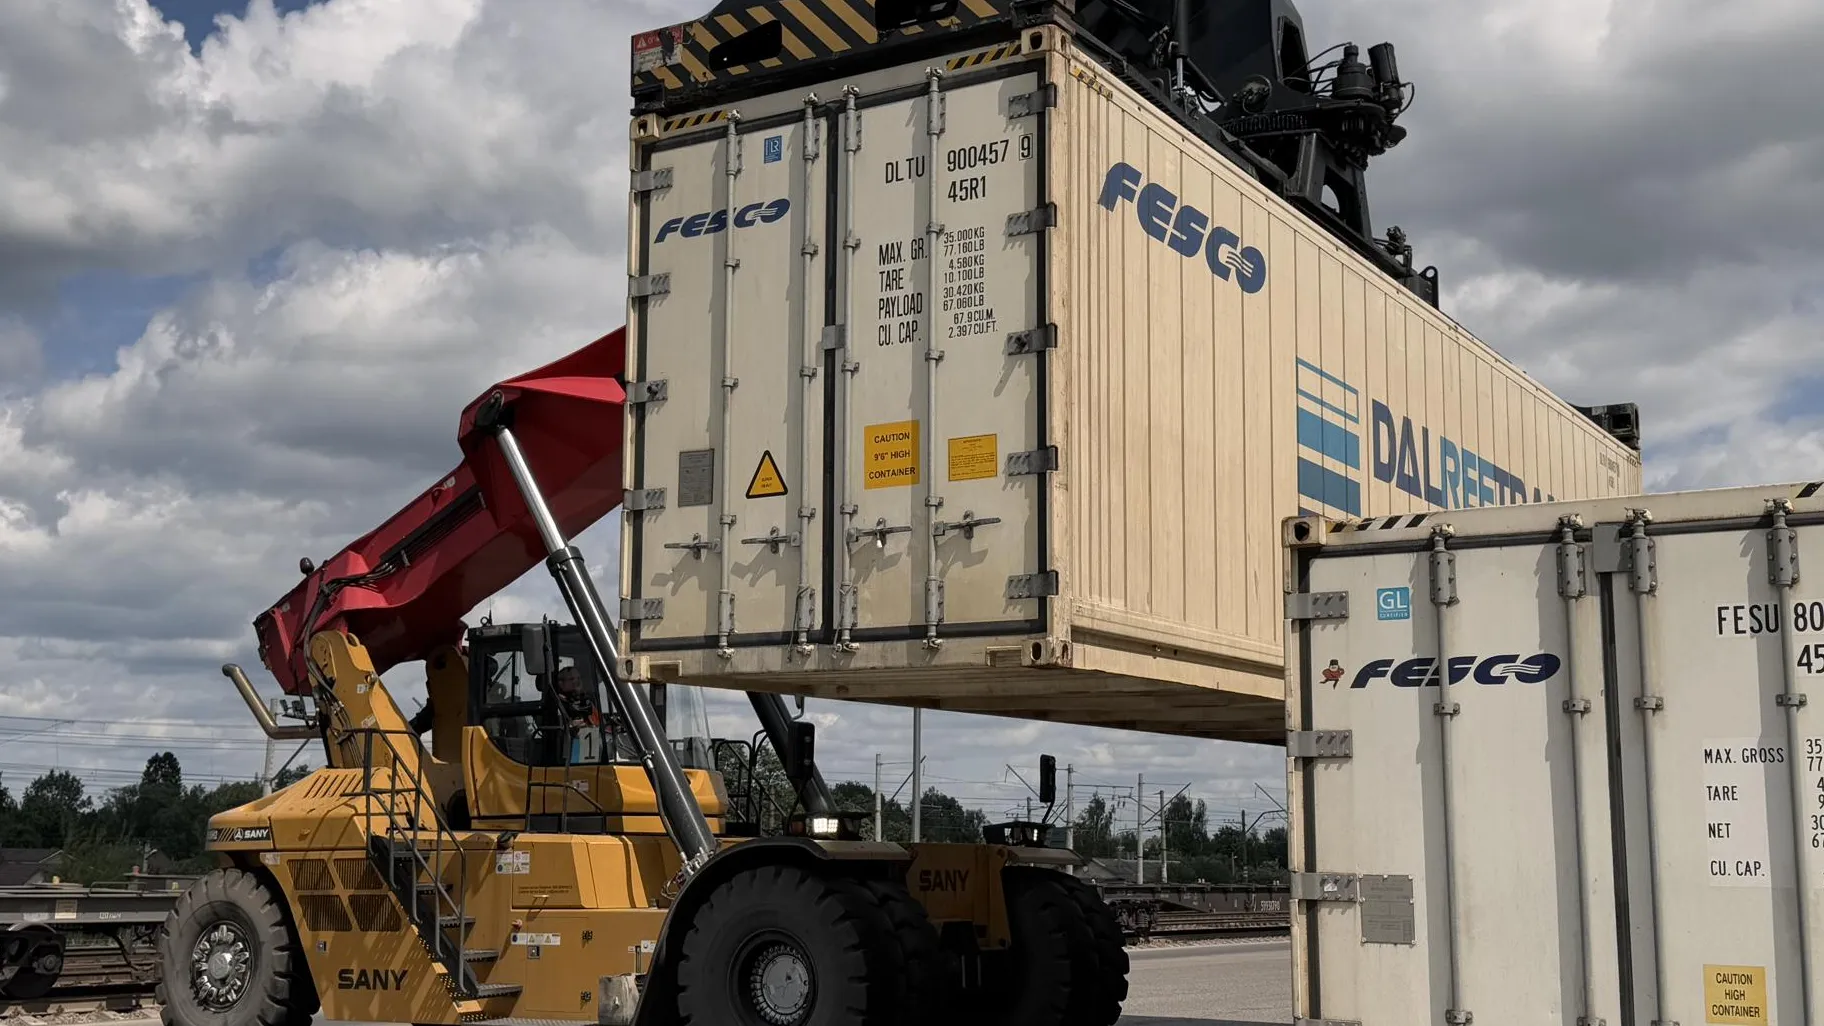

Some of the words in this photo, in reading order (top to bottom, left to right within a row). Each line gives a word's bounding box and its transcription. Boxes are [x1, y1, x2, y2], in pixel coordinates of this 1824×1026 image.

[885, 155, 925, 184] DLTU
[947, 139, 1009, 172] 900457
[1021, 135, 1031, 158] 9
[947, 175, 986, 203] 45R1
[654, 198, 790, 243] FESCO
[1097, 162, 1266, 293] FESCO
[879, 241, 906, 266] MAX.
[911, 237, 928, 260] GR.
[879, 268, 904, 292] TARE
[878, 292, 923, 320] PAYLOAD
[878, 324, 894, 346] CU.
[899, 320, 922, 344] CAP.
[874, 432, 910, 443] CAUTION
[890, 450, 910, 460] HIGH
[868, 466, 916, 480] CONTAINER
[1379, 590, 1408, 609] GL
[1717, 603, 1779, 635] FESU
[1793, 601, 1824, 632] 80
[1350, 653, 1561, 689] FESCO
[1796, 644, 1824, 674] 45
[584, 731, 595, 760] 1
[1704, 748, 1737, 764] MAX.
[1742, 747, 1785, 763] GROSS
[1806, 738, 1822, 754] 35
[1806, 756, 1823, 771] 77
[1706, 786, 1739, 801] TARE
[244, 828, 269, 839] SANY
[1708, 823, 1731, 838] NET
[919, 868, 970, 892] SANY
[1710, 860, 1731, 876] CU.
[1735, 860, 1765, 877] CAP.
[338, 968, 408, 991] SANY
[1715, 972, 1753, 985] CAUTION
[1724, 988, 1746, 1001] HIGH
[1711, 1004, 1760, 1018] CONTAINER
